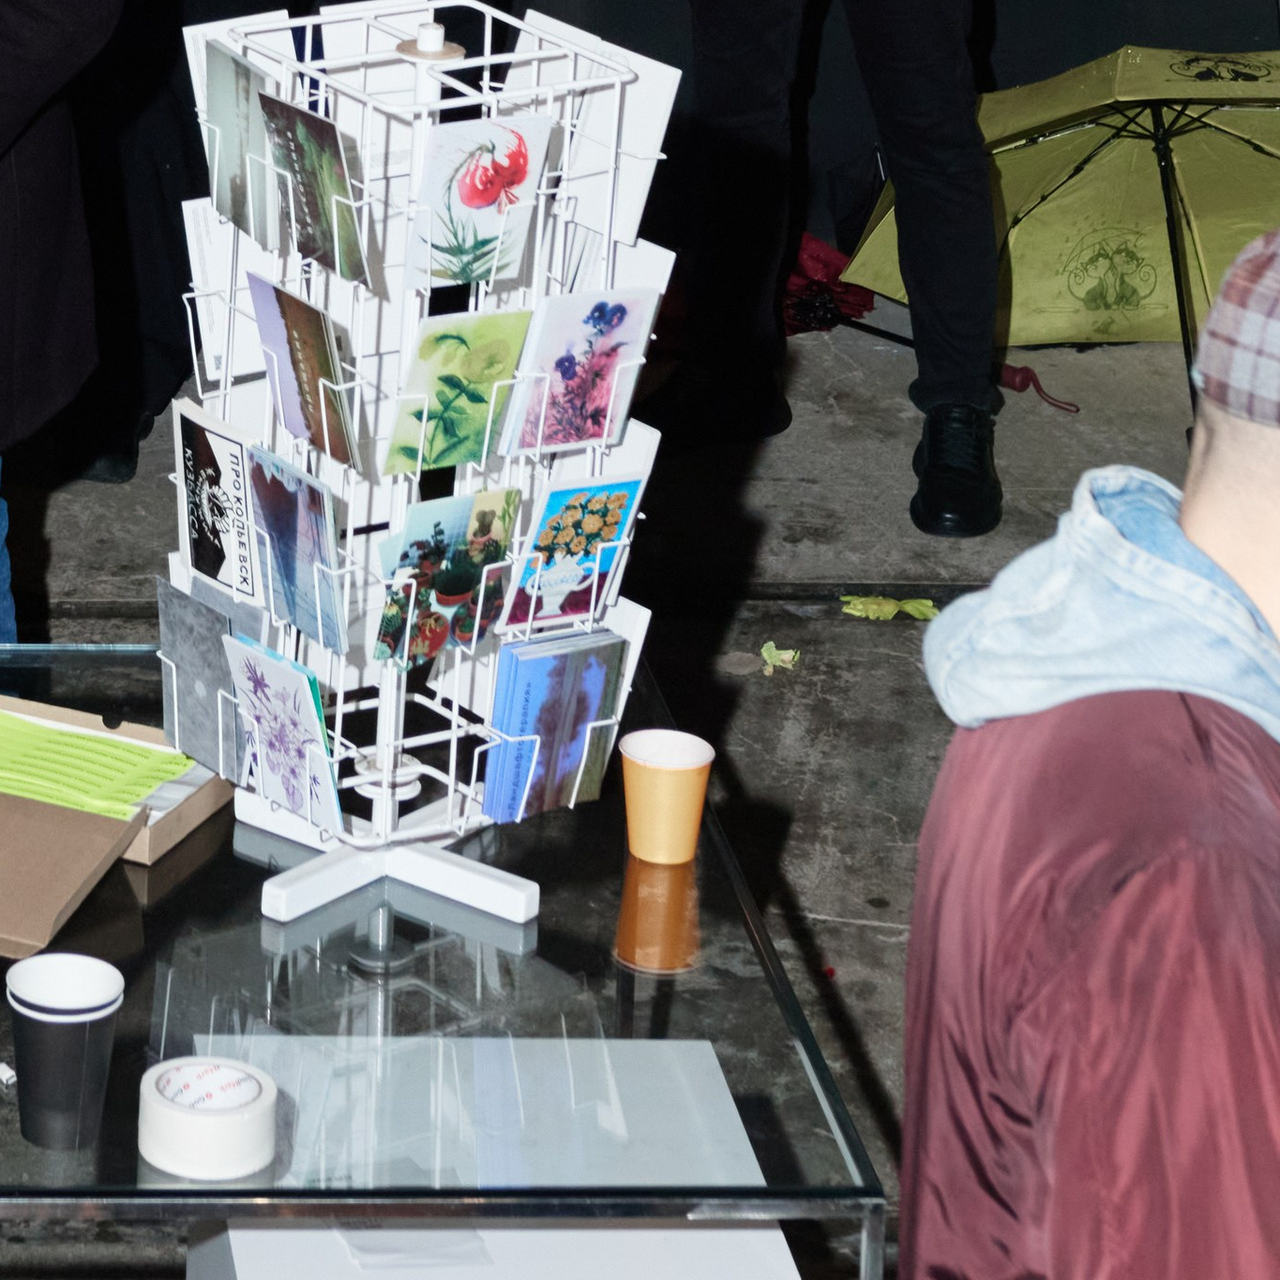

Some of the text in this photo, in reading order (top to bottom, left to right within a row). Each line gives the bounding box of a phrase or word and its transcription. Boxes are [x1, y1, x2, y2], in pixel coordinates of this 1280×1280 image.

[184, 447, 199, 539] КУЗБАССА
[229, 451, 250, 587] ПРОКОПЬЕВСК
[508, 681, 533, 818] «Ландшафтоерапия»
